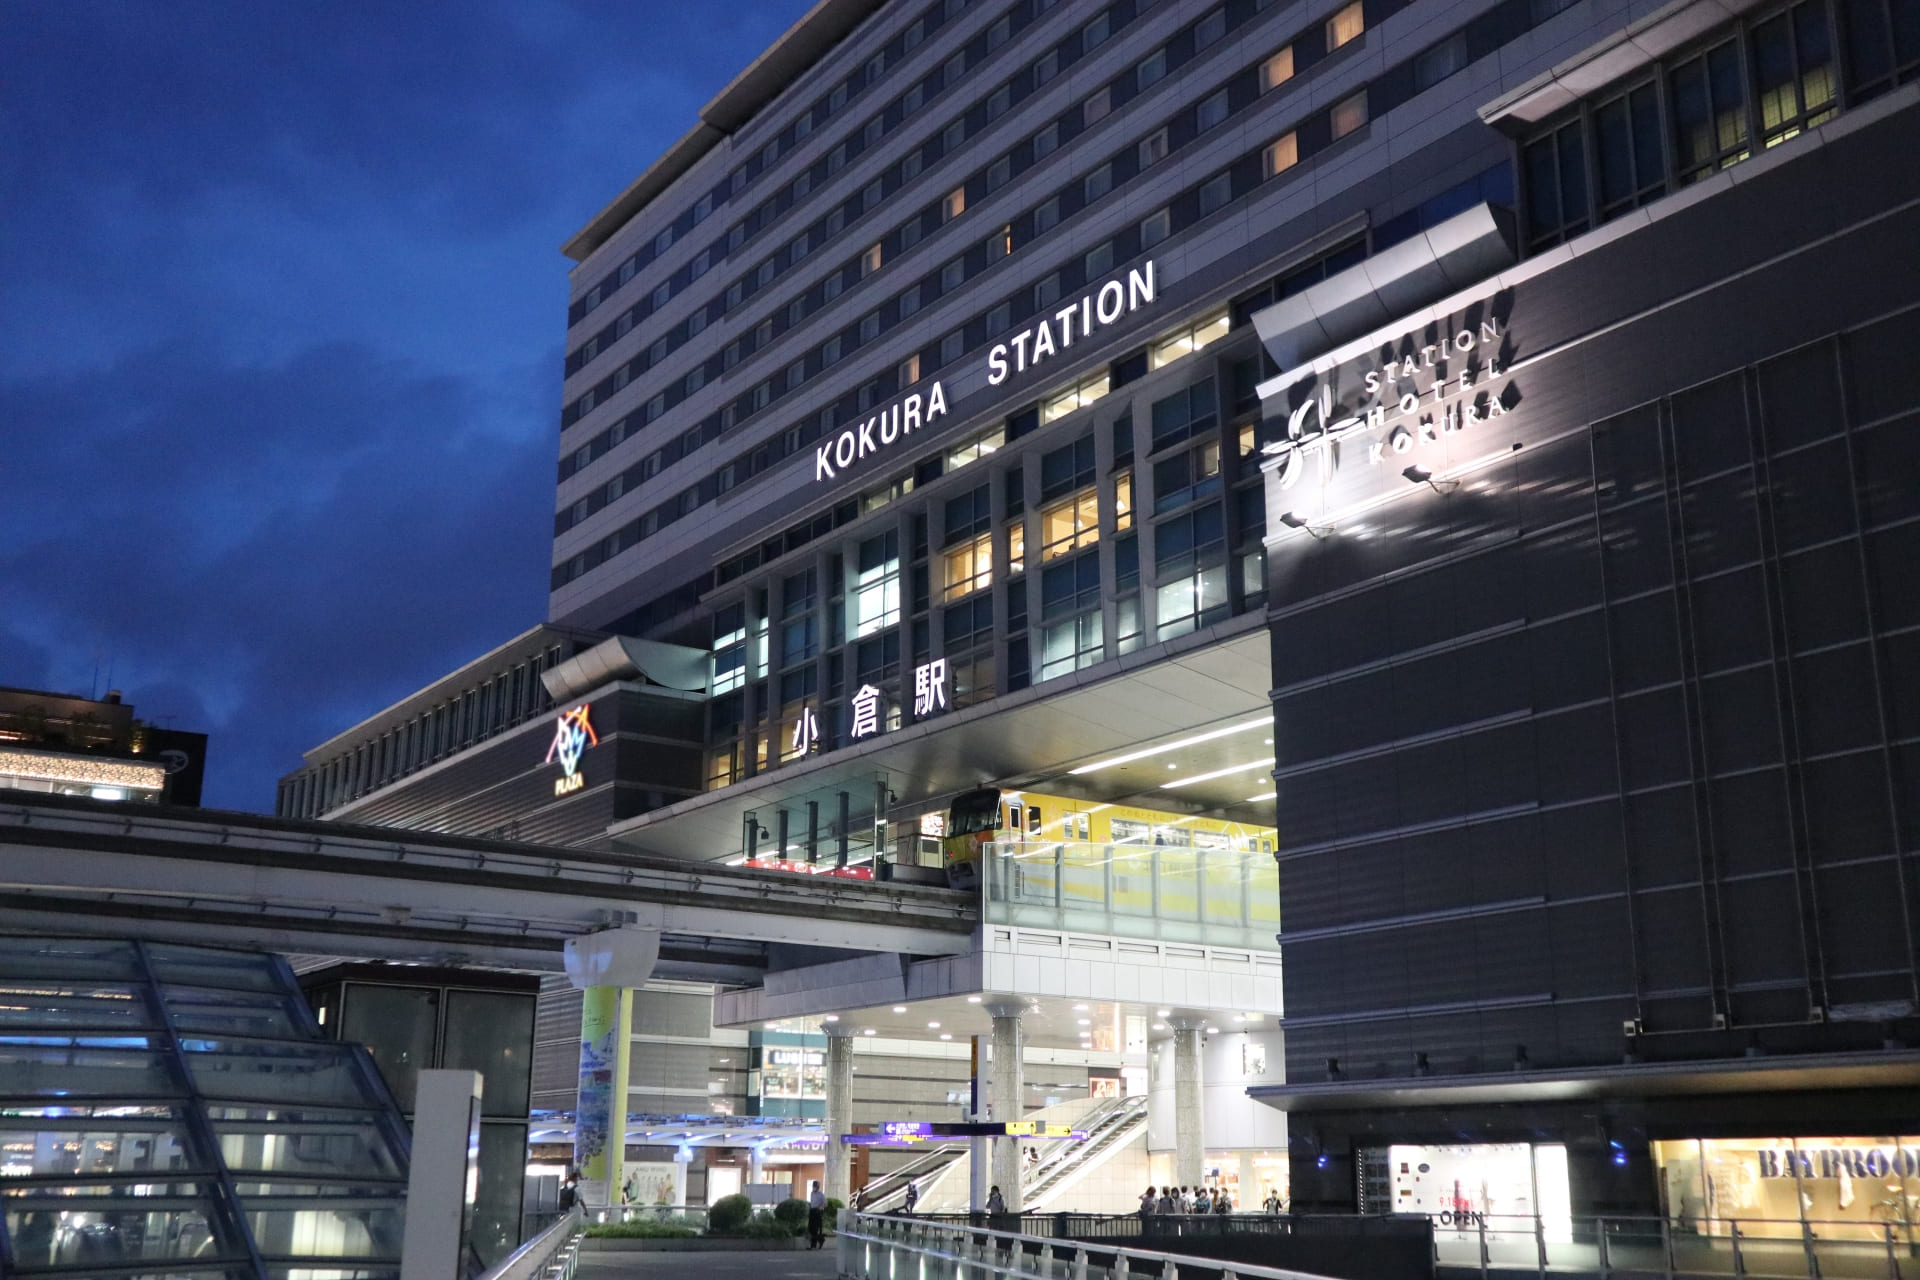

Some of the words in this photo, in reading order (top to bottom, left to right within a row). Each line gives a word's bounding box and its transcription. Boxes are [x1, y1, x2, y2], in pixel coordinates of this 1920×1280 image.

[816, 381, 948, 480] KOKURA
[988, 260, 1155, 385] STATION
[1365, 317, 1500, 393] STATION
[1367, 358, 1502, 430] HOTEL
[1369, 395, 1508, 465] KOKURA
[792, 658, 946, 756] 小倉駅
[555, 771, 583, 796] PLAZA
[1757, 1149, 1920, 1178] BAYBROO
[1440, 1210, 1483, 1226] OPEN
